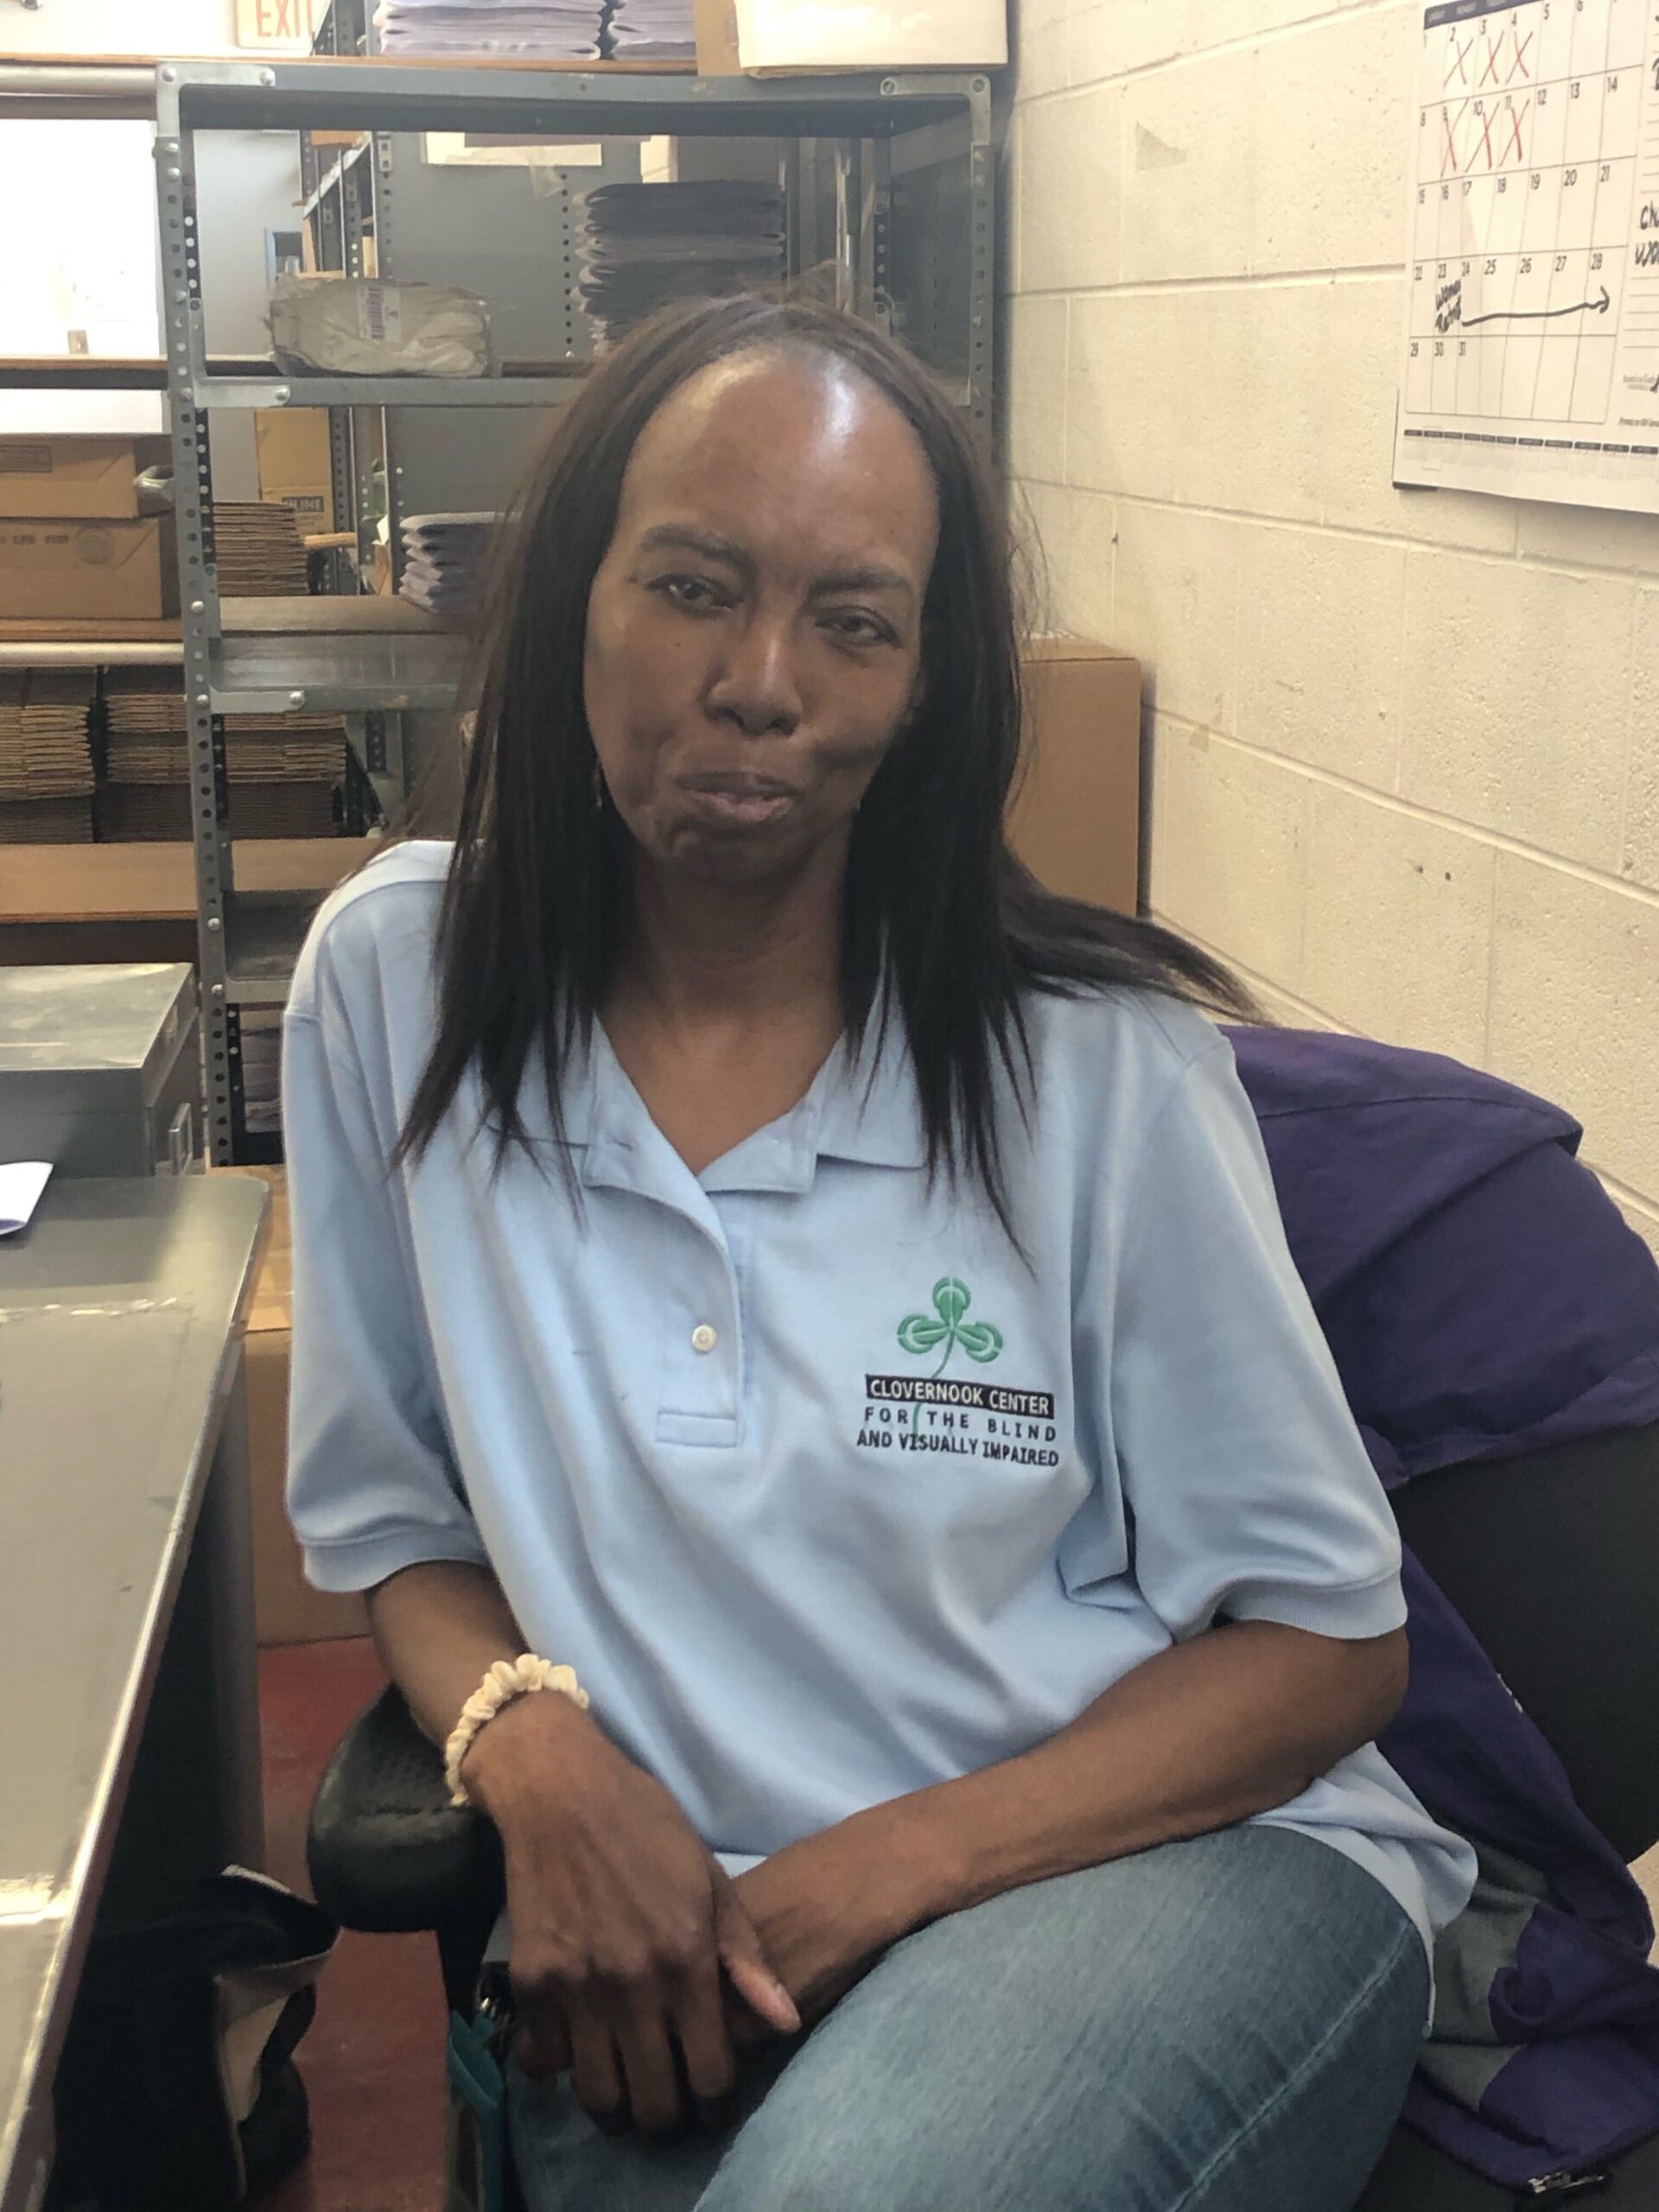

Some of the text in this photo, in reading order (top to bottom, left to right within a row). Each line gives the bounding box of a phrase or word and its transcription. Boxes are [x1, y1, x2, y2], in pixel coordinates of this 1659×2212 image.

[1450, 26, 1456, 42] 2
[1480, 19, 1487, 35] 3
[1510, 12, 1517, 26] 4
[1543, 3, 1550, 20] 5
[1473, 100, 1484, 116] 10
[1505, 95, 1512, 110] 11
[1537, 89, 1547, 105] 12
[1570, 82, 1580, 99] 13
[1607, 75, 1618, 92] 14
[1462, 181, 1471, 196] 17
[1497, 178, 1506, 194] 18
[1530, 174, 1541, 190] 19
[1564, 169, 1577, 187] 20
[1599, 165, 1610, 182] 21
[1438, 263, 1446, 278] 23
[1461, 261, 1470, 276] 24
[1484, 259, 1497, 275] 25
[1520, 257, 1532, 274] 26
[1554, 255, 1567, 272] 27
[1591, 251, 1603, 270] 28
[1410, 341, 1466, 357] 29 30 31
[869, 1378, 1050, 1415] CLOVERNOOK CENTER
[865, 1406, 1056, 1442] FOR THE BLIND
[857, 1428, 1059, 1467] AND VISUALLY IMPAIRED
